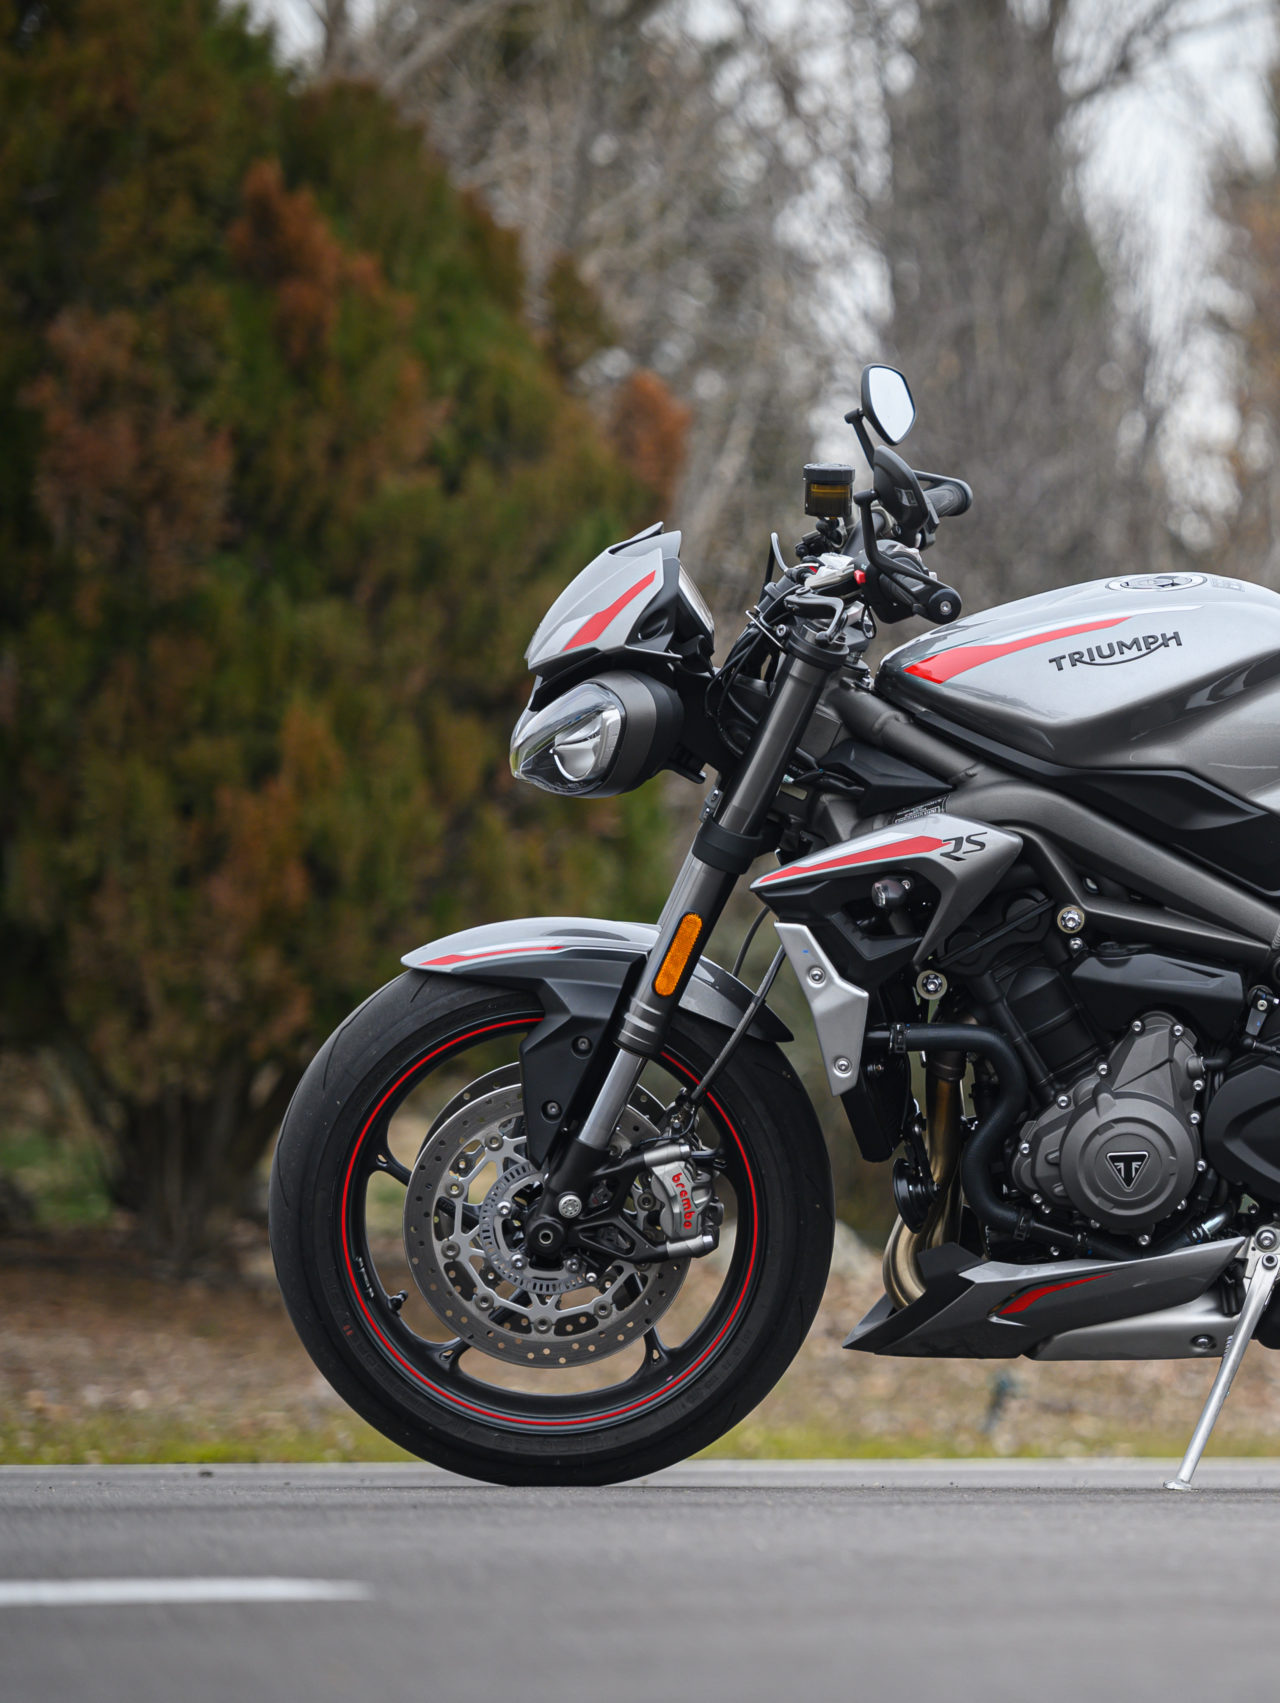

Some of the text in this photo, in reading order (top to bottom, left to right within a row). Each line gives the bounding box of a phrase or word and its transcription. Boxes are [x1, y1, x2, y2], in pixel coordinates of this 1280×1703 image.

[1048, 631, 1182, 671] TRIUMPH
[940, 831, 988, 862] RS
[671, 1172, 696, 1230] brembo
